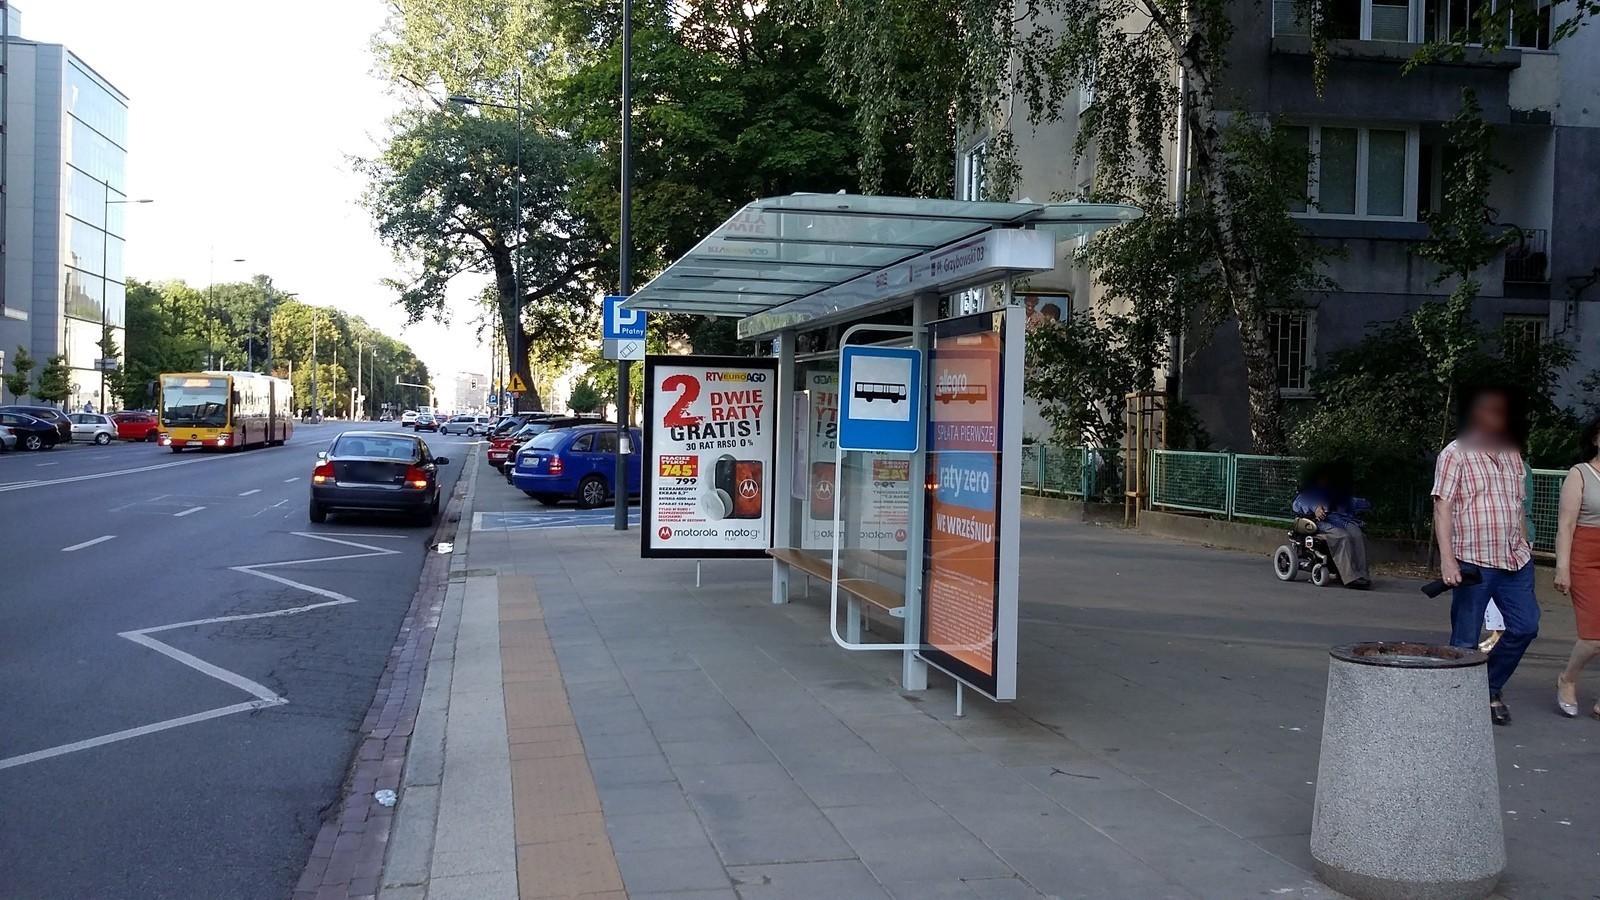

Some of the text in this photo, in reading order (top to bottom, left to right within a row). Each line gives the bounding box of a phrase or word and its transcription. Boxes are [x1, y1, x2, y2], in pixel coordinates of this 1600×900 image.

[944, 248, 976, 272] Grzybowski
[977, 246, 984, 262] 03
[621, 327, 644, 336] Płatny
[938, 368, 967, 399] allegro
[661, 374, 706, 428] 2
[710, 390, 763, 406] DWIE
[711, 405, 763, 421] RATY
[961, 425, 996, 447] PIERWSZEJ
[686, 442, 696, 451] 30
[700, 441, 714, 450] RAT
[717, 439, 737, 449] RRSO
[661, 464, 692, 476] 745
[940, 464, 989, 497] raty zero
[674, 529, 718, 537] motorola
[725, 528, 749, 537] moto
[936, 512, 992, 544] WE WRZEŚNIU
